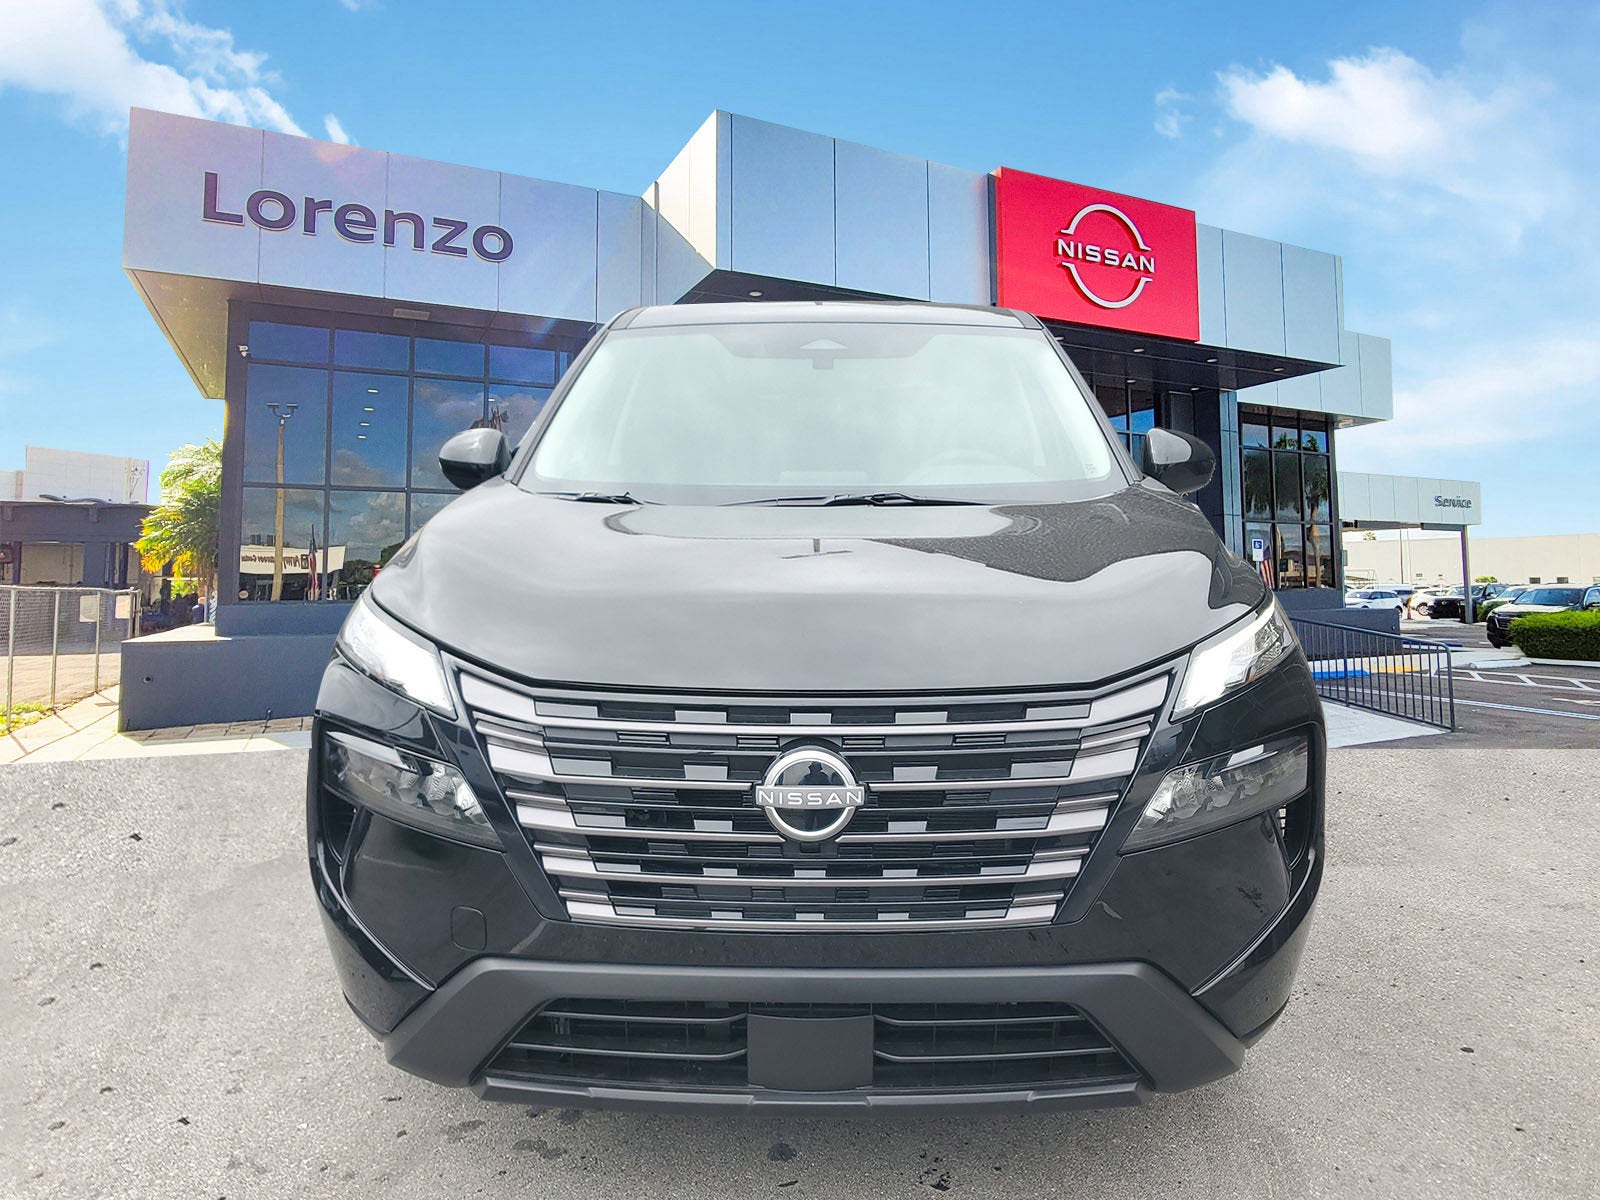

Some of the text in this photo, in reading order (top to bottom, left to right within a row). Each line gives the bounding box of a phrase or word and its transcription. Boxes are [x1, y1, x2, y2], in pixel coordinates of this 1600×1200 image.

[203, 171, 514, 262] Lorenzo
[1058, 238, 1155, 273] NISSAN
[1434, 495, 1472, 508] Service
[758, 790, 862, 806] NISSAN
